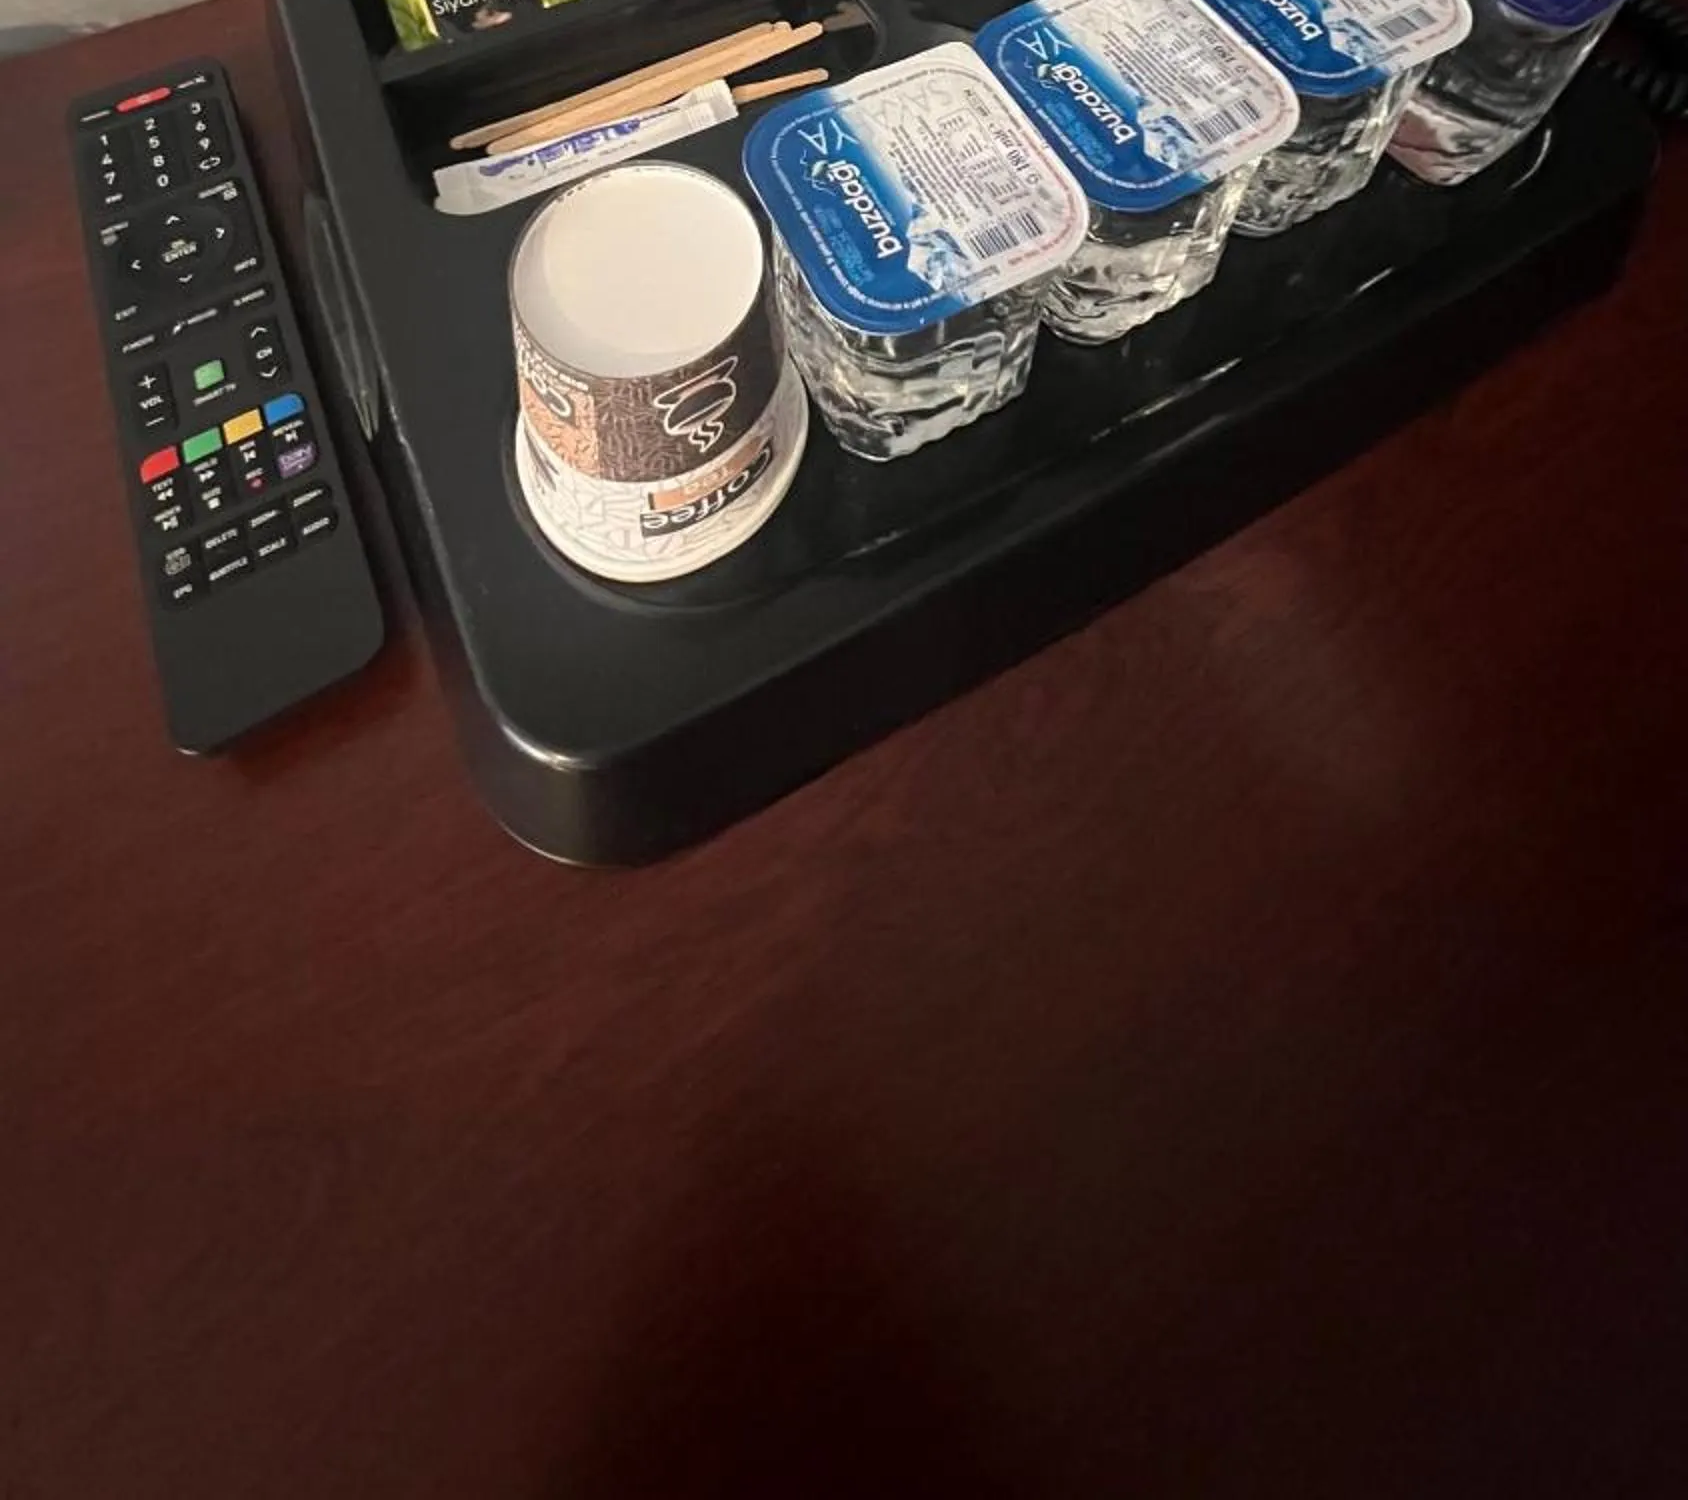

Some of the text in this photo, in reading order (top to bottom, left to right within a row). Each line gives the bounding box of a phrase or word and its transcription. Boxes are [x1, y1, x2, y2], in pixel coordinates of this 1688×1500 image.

[100, 135, 108, 146] 1
[145, 118, 156, 130] 2
[101, 121, 206, 165] 4 5 6
[104, 138, 210, 185] 7 8 9
[1005, 148, 1029, 172] 180
[157, 174, 168, 187] 0
[828, 158, 904, 260] buzdağı
[139, 396, 164, 409] VOL
[642, 444, 774, 532] Coffee
